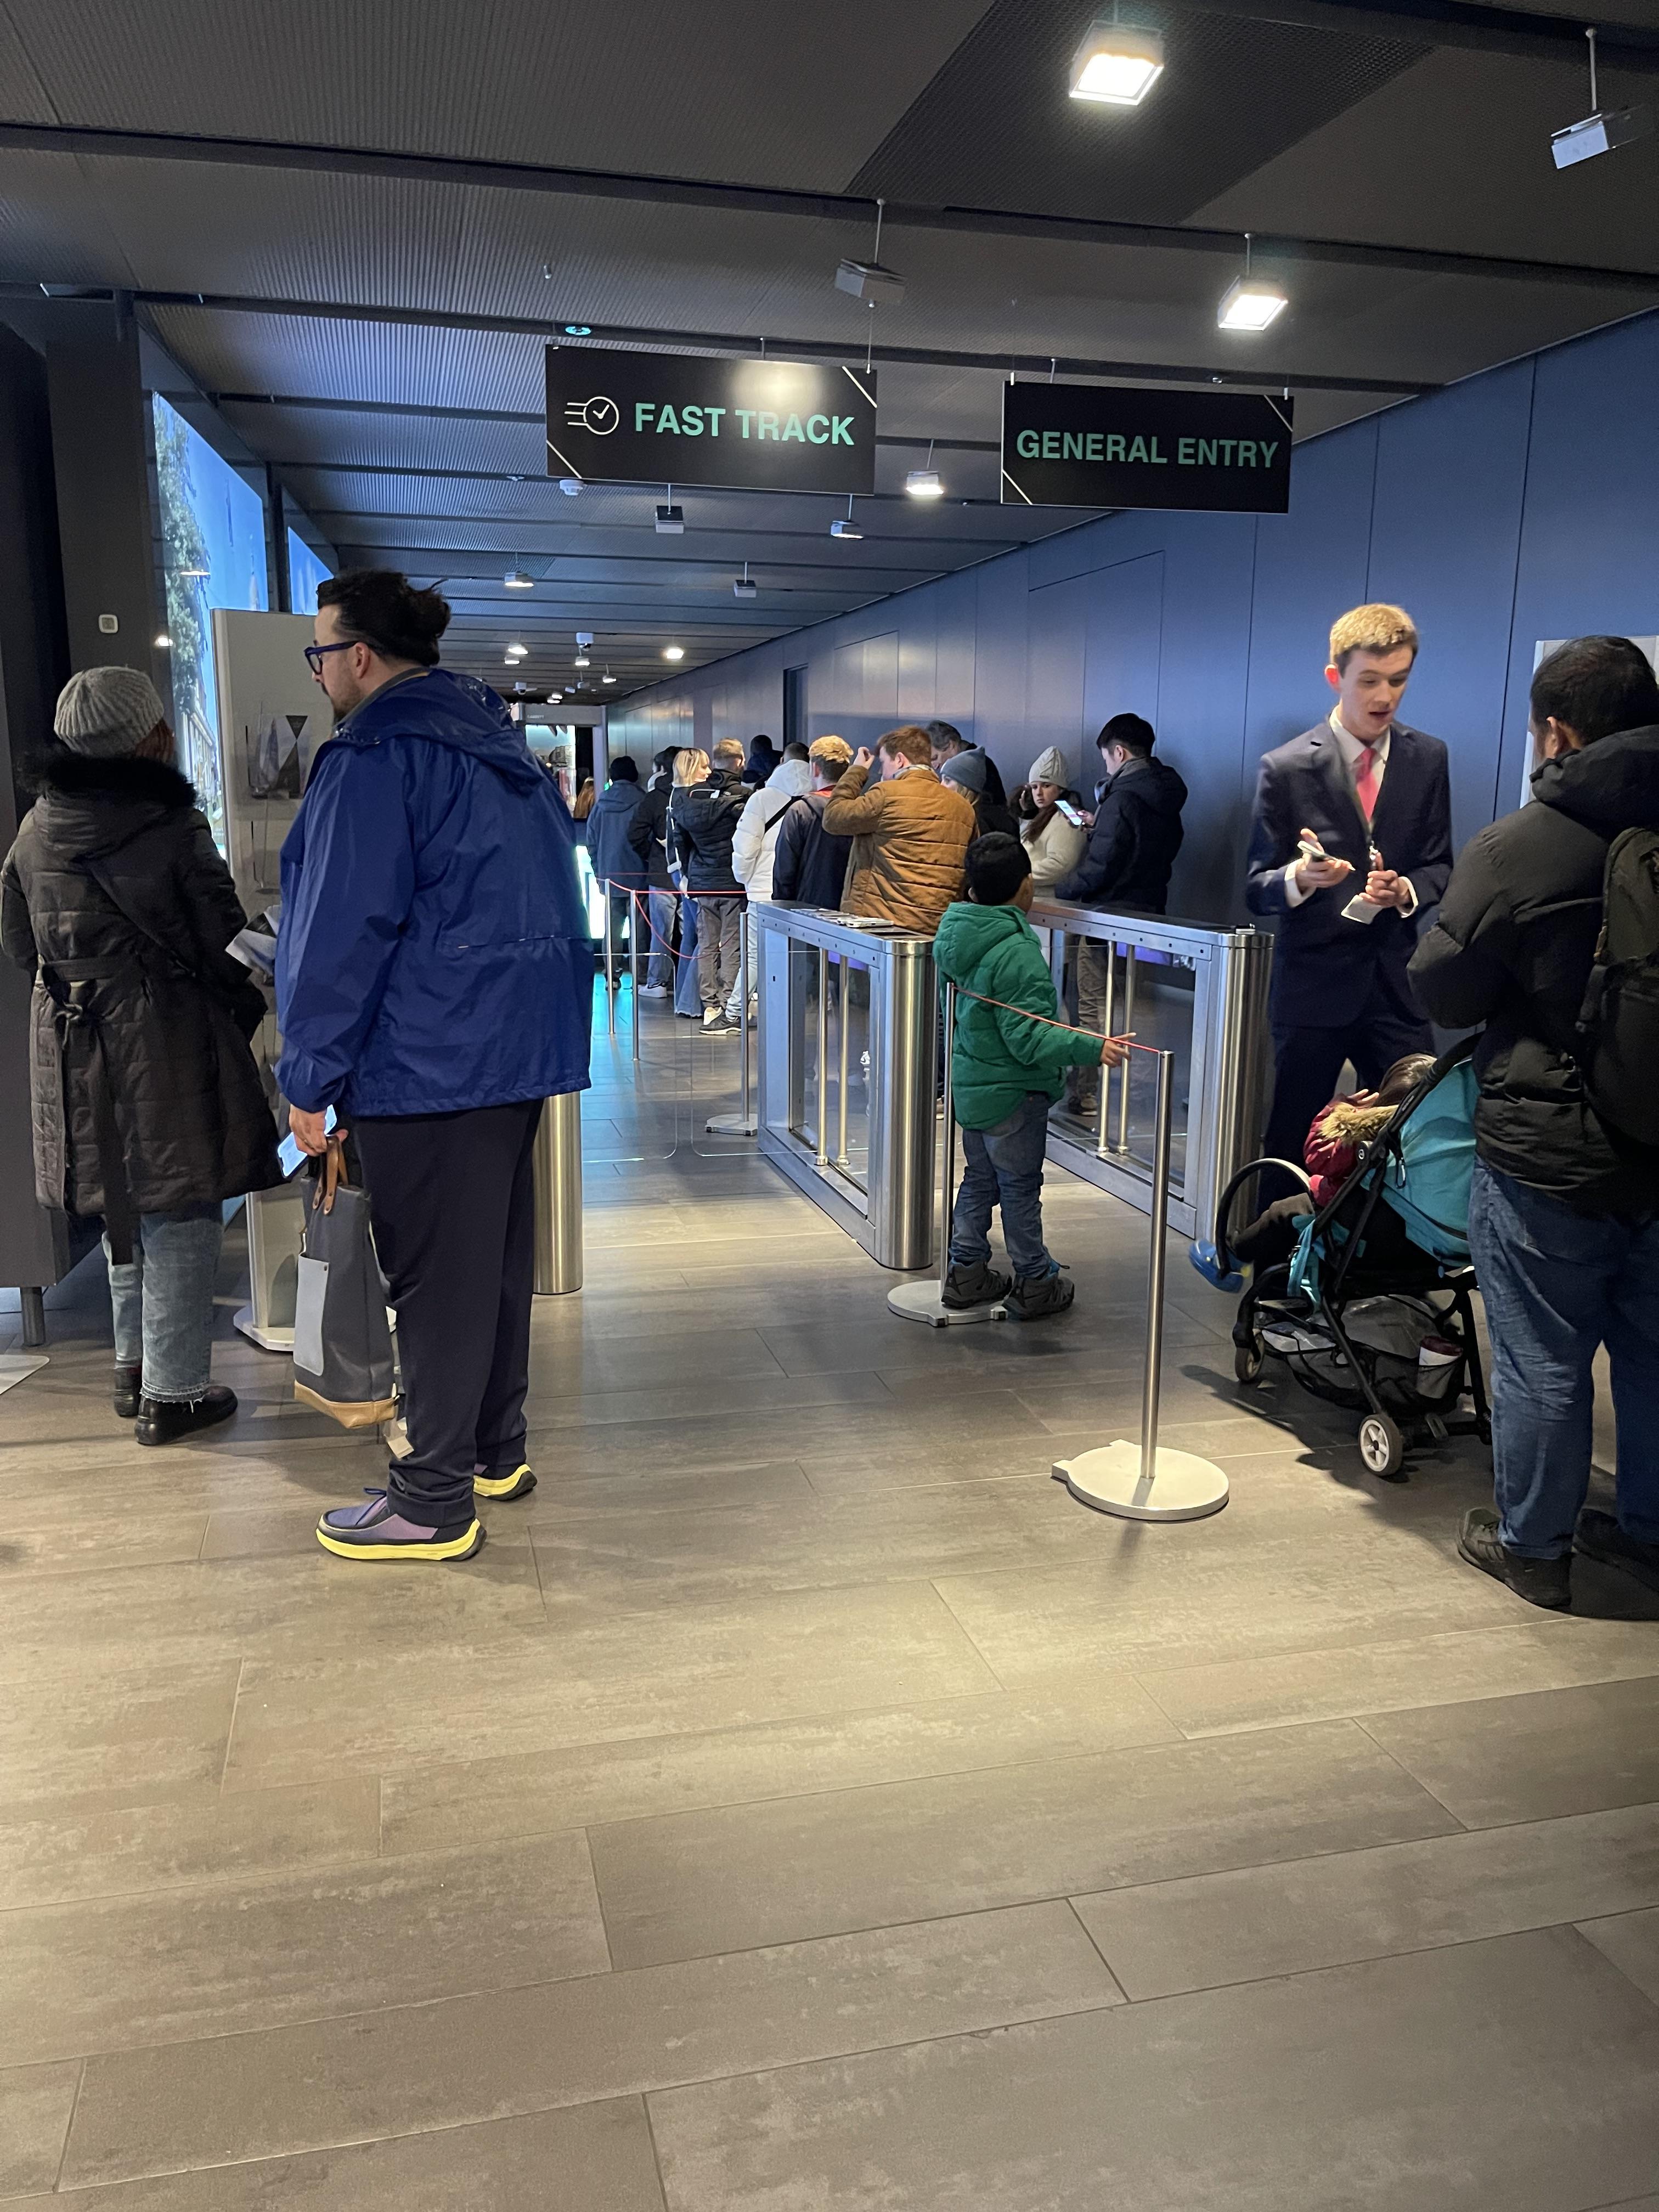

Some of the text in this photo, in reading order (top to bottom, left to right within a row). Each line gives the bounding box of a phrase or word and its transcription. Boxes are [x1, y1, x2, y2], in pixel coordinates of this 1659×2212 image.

[635, 403, 855, 445] FAST TRACK
[1017, 430, 1279, 468] GENERAL ENTRY
